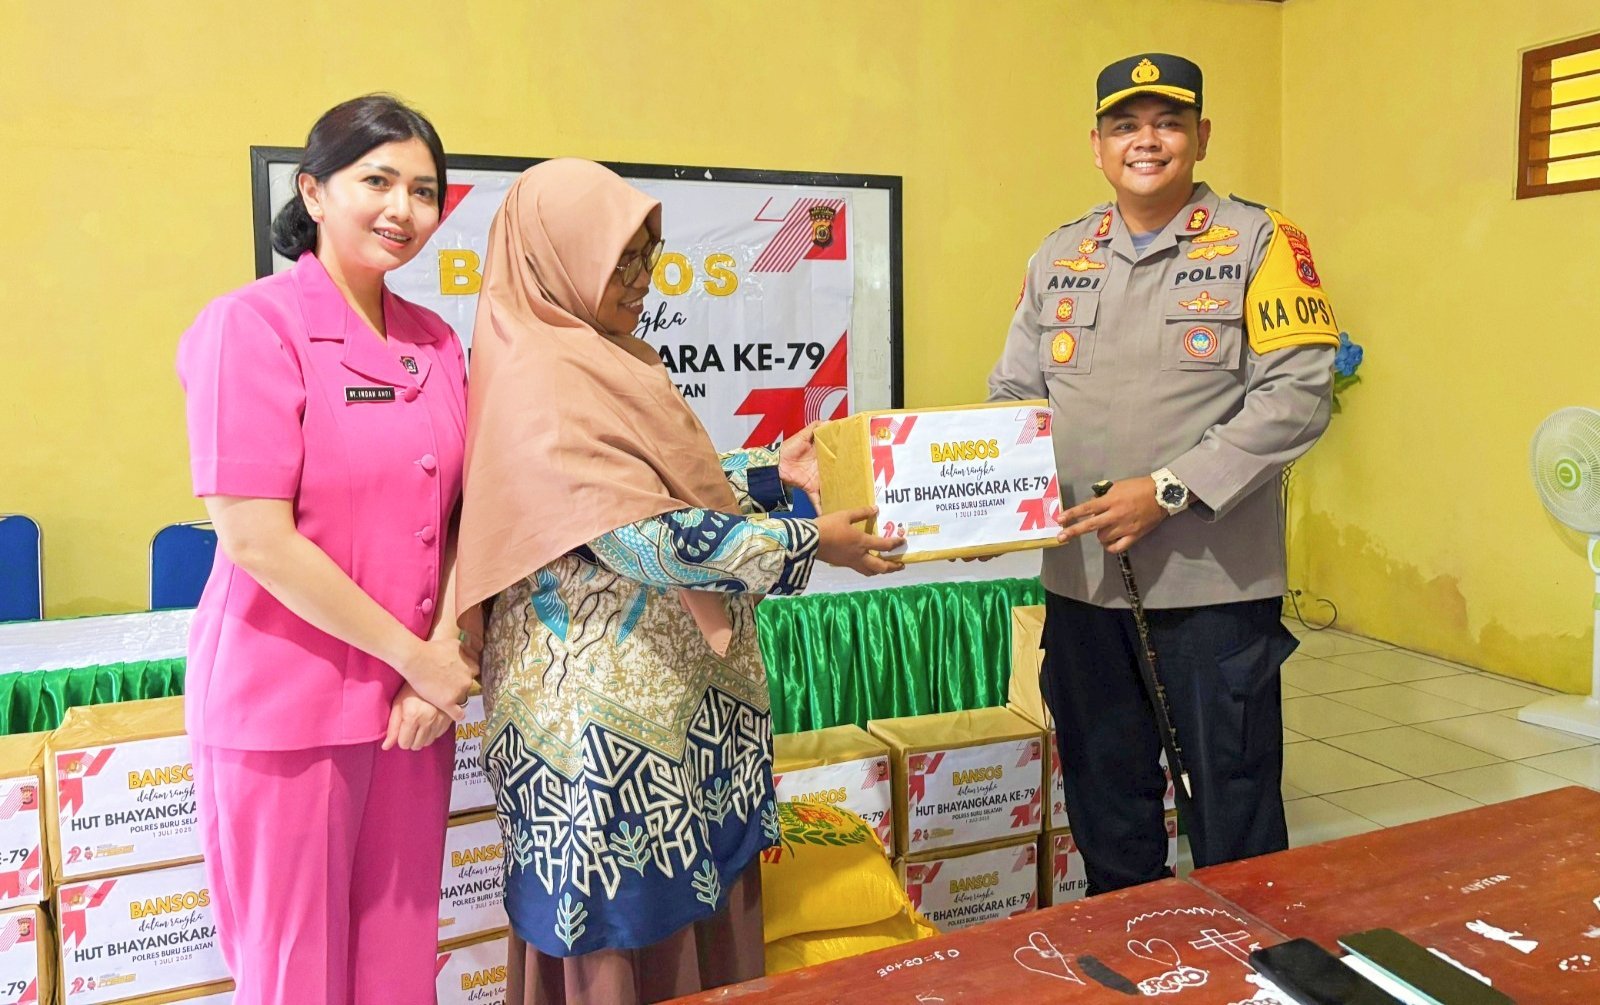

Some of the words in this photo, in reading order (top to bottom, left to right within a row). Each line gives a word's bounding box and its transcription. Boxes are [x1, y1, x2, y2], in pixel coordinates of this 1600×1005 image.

[1048, 276, 1100, 290] ANDI
[1175, 264, 1241, 285] POLRI
[634, 301, 687, 338] gka
[1259, 298, 1289, 332] KA
[1295, 296, 1330, 325] OPS
[734, 342, 825, 372] KE-79
[930, 439, 1000, 463] BANSOS
[940, 464, 965, 477] dalam
[966, 461, 996, 480] rangka
[885, 488, 911, 504] HUT
[914, 480, 1010, 502] BHAYANGKARA
[1013, 476, 1048, 492] KE-79
[936, 503, 960, 512] POLRES
[961, 501, 977, 509] BURU
[979, 498, 1005, 508] SELATAN
[456, 720, 488, 741] ANS
[128, 763, 194, 789] BANSO
[452, 772, 470, 781] OLRES
[952, 765, 1003, 786] BANSOS
[137, 789, 168, 802] dalam
[170, 782, 195, 801] rangk
[916, 805, 935, 816] HUT
[938, 796, 1007, 814] BHAYANGKARA
[1010, 788, 1035, 801] KE-79
[71, 815, 100, 831] HUT
[105, 801, 196, 826] BHAYANGKA
[130, 824, 158, 833] POLRES
[160, 821, 179, 829] BURU
[181, 817, 198, 825] SELA
[0, 848, 29, 864] -79
[451, 843, 504, 868] BANSO
[440, 877, 504, 899] HAYANGK
[950, 871, 998, 894] BANSOS
[1059, 881, 1076, 892] HUT
[130, 888, 210, 920] BANSOS
[452, 897, 475, 907] POLRES
[477, 894, 493, 902] BURU
[934, 900, 1004, 921] BHAYANGKARA
[1006, 893, 1030, 907] KE-79
[138, 918, 169, 932] dalam
[170, 910, 204, 929] rangka
[74, 946, 103, 962] HUT
[132, 953, 160, 962] POLRES
[162, 949, 181, 958] BURU
[182, 941, 214, 954] SELATAN
[0, 981, 27, 996] -79
[461, 966, 507, 990] BANS
